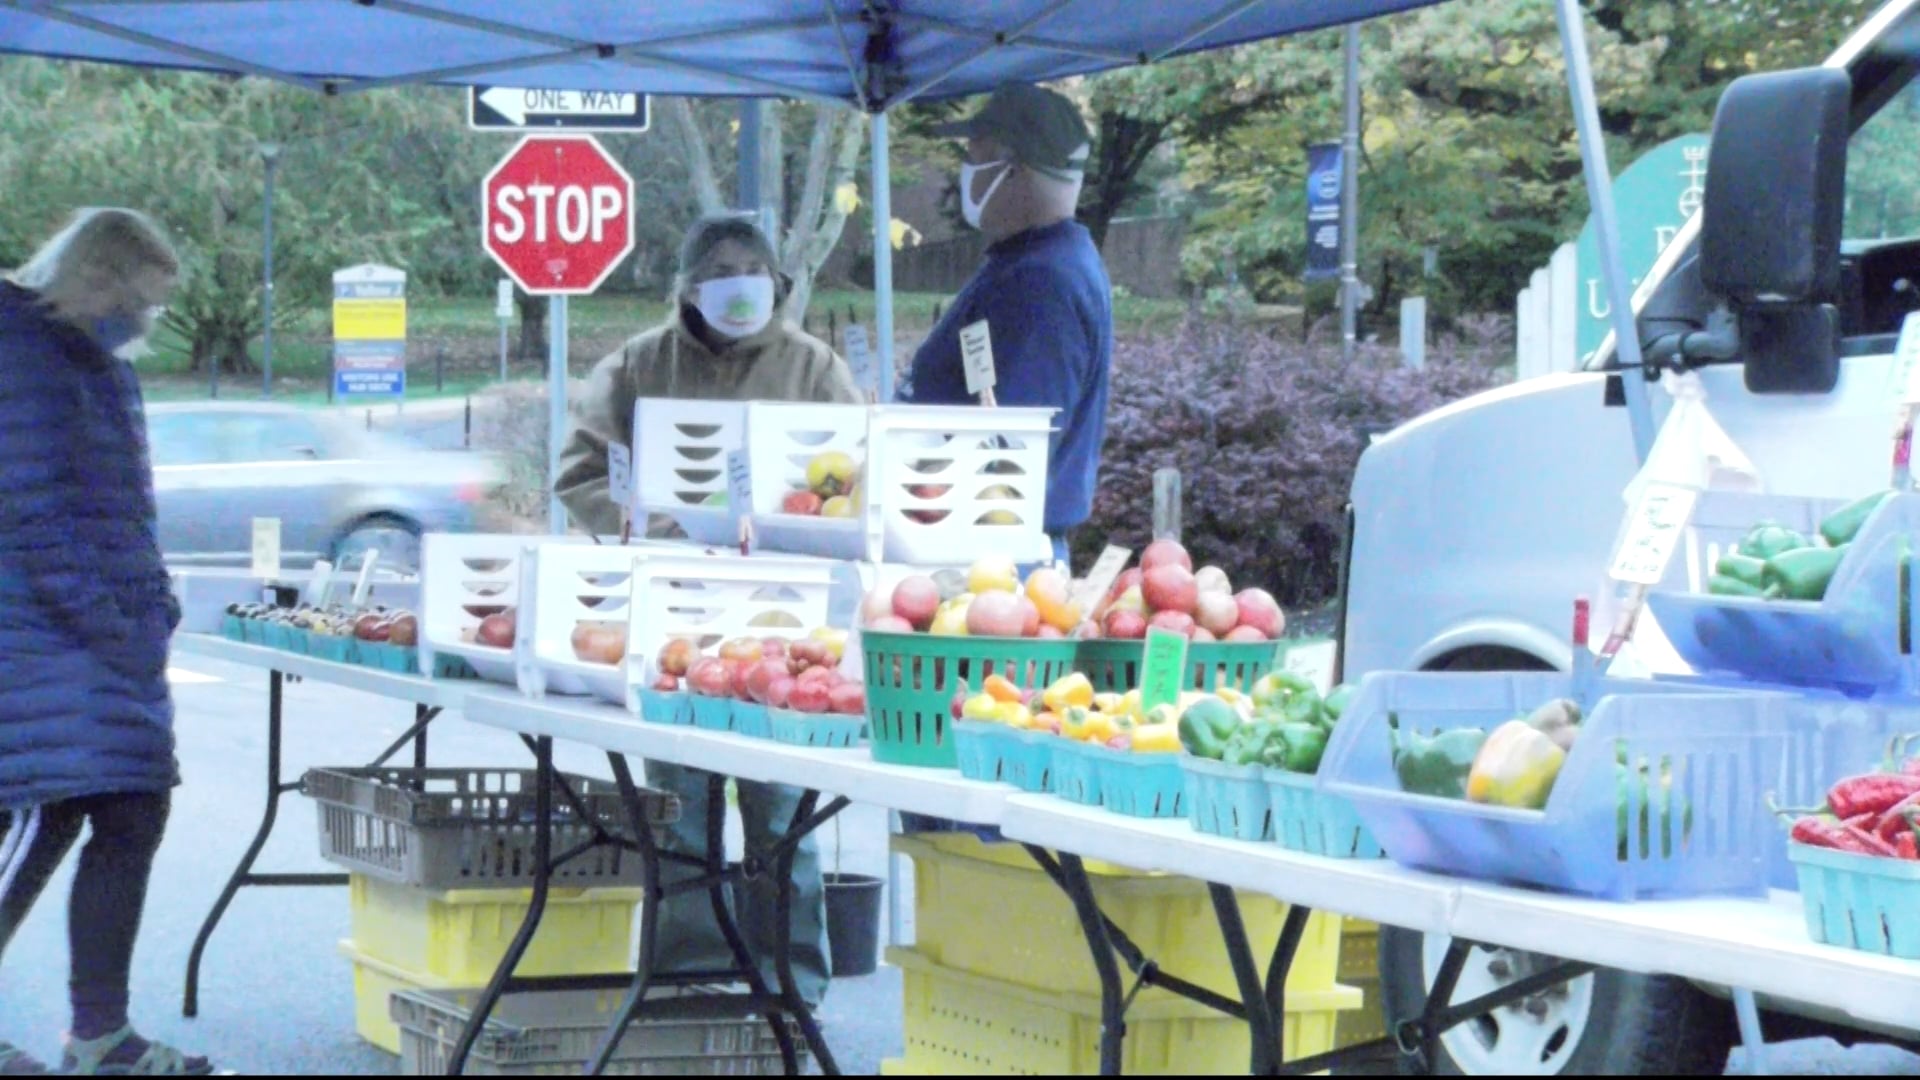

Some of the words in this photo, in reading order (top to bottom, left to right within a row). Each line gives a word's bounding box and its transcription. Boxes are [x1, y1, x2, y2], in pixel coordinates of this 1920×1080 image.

[525, 88, 569, 110] ONE
[580, 90, 625, 110] WAY
[494, 185, 622, 243] STOP
